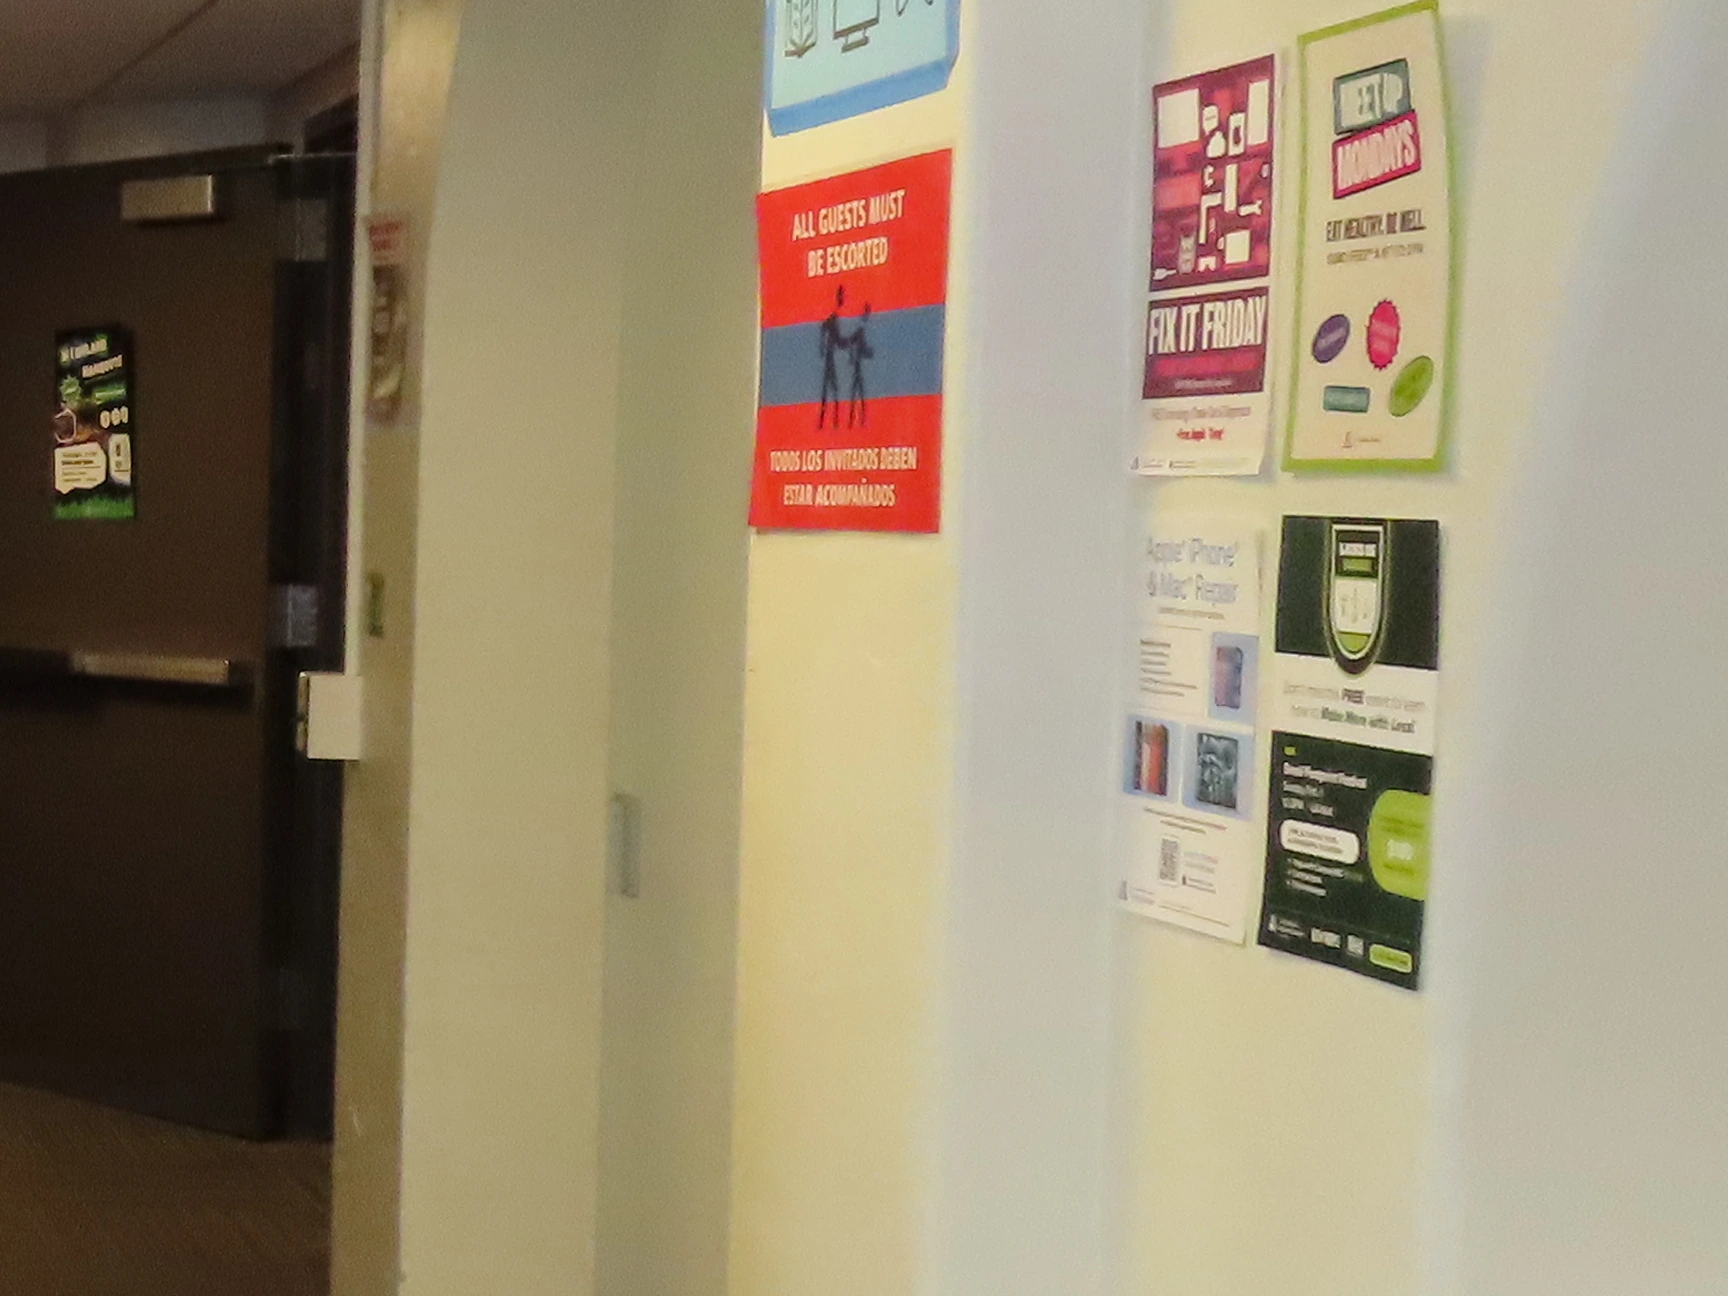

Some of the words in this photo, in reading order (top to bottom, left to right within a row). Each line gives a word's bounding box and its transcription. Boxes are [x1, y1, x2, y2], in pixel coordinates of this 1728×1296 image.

[1337, 118, 1417, 191] MONDAYS
[791, 210, 817, 242] ALL
[818, 198, 867, 236] GUESTS
[868, 188, 907, 225] MUST
[826, 235, 889, 275] ESCORTED
[1148, 306, 1179, 355] FIX
[1180, 303, 1203, 352] IT
[1202, 294, 1267, 351] FRIDAY
[770, 450, 801, 472] TODOS
[801, 449, 823, 472] LOS
[824, 447, 879, 472] INVITADOS
[879, 446, 918, 471] DEBEN
[783, 482, 813, 506] ESTAR
